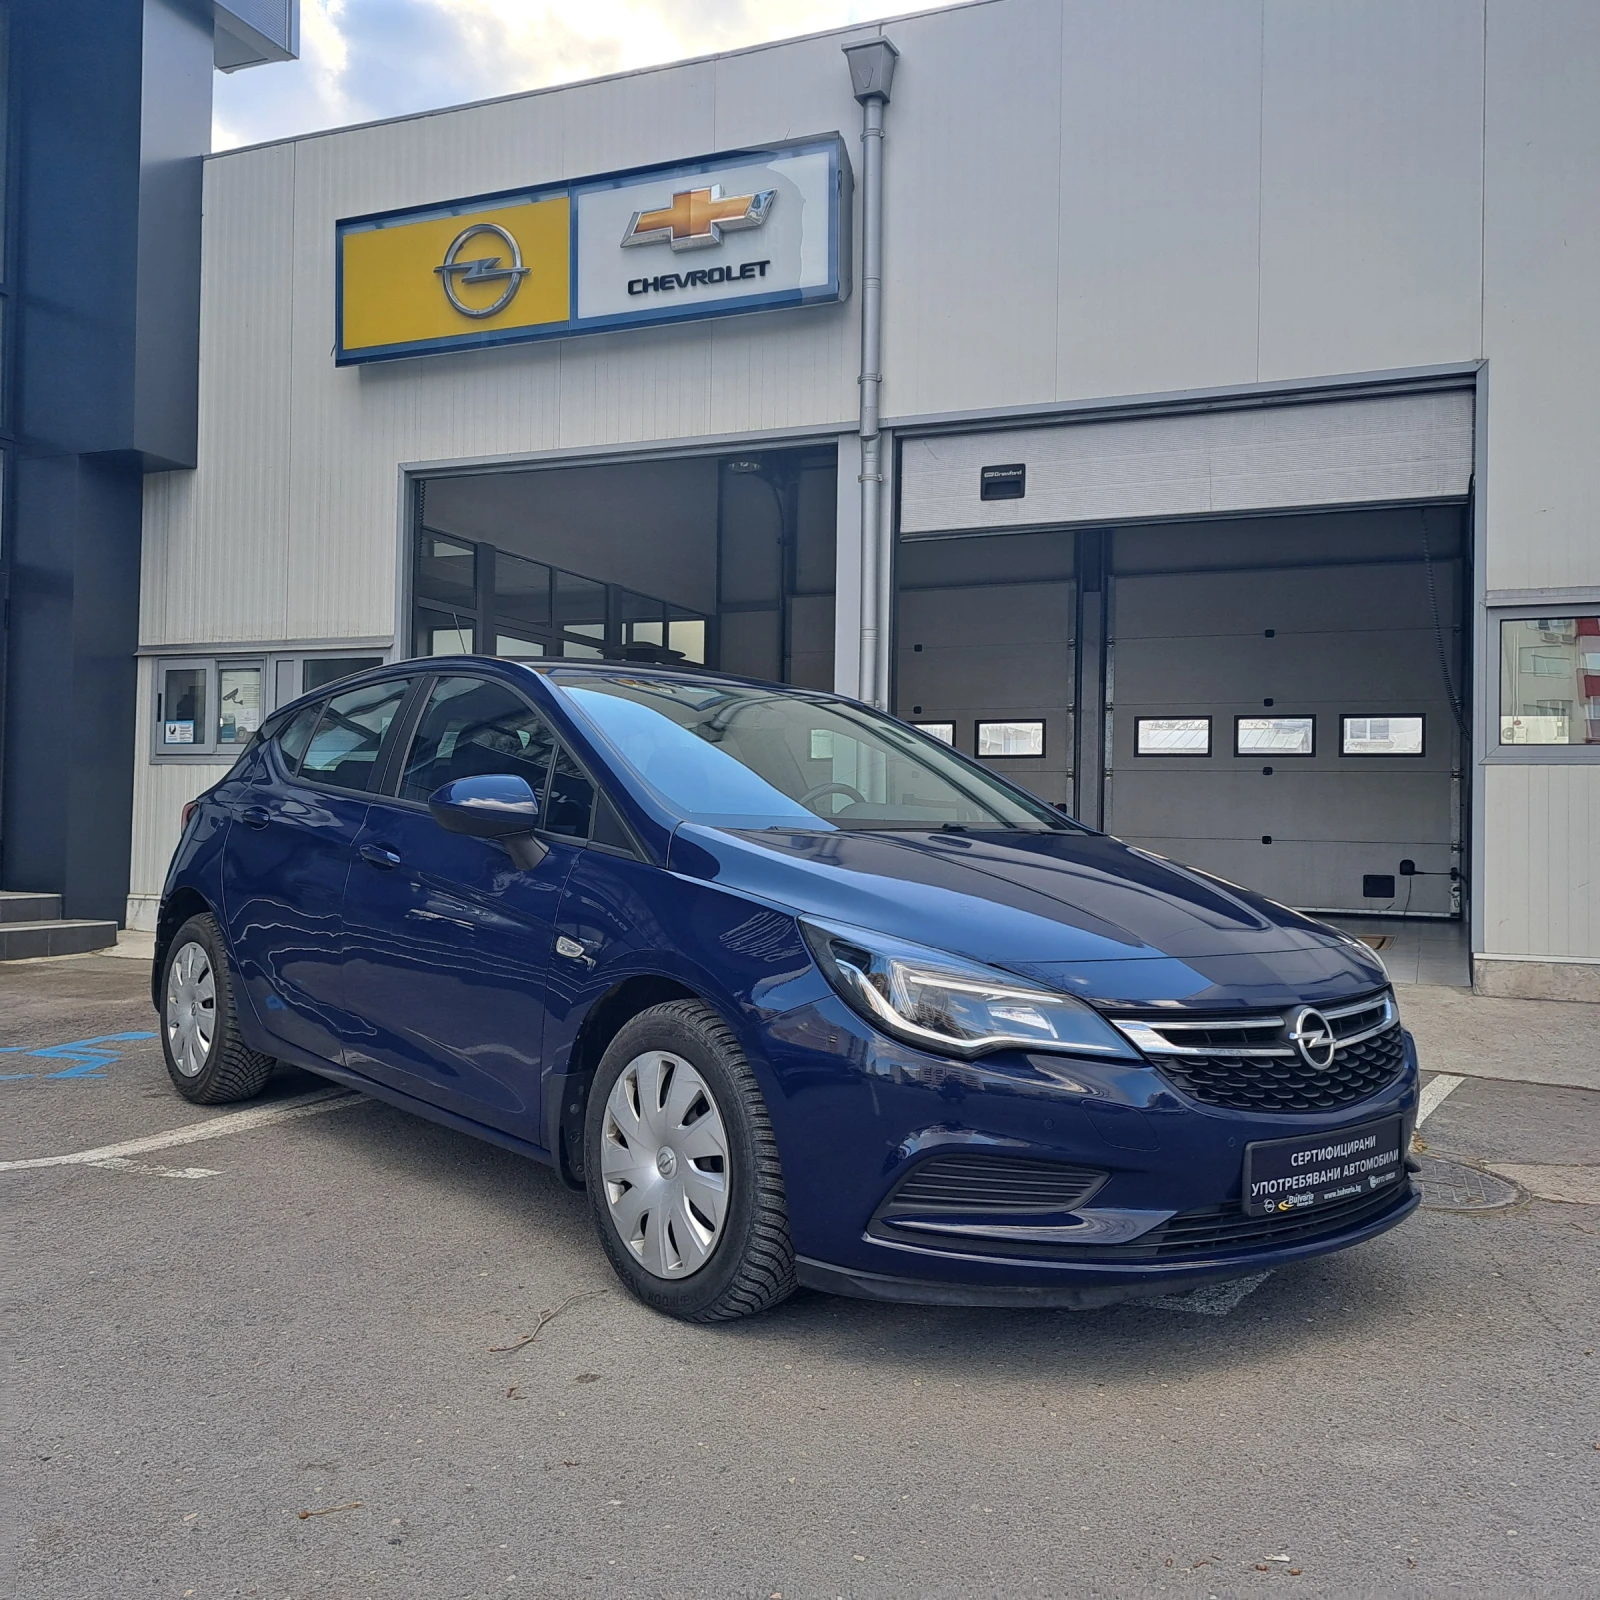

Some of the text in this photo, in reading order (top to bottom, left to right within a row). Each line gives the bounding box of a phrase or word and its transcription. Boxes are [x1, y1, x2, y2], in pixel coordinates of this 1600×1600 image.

[628, 260, 771, 295] CHEVROLET
[1291, 1135, 1376, 1167] СЕРТИФИЦИРАНИ
[1251, 1149, 1399, 1197] УПОТРЕБЯВАНИ АВТОМОБИЛИ
